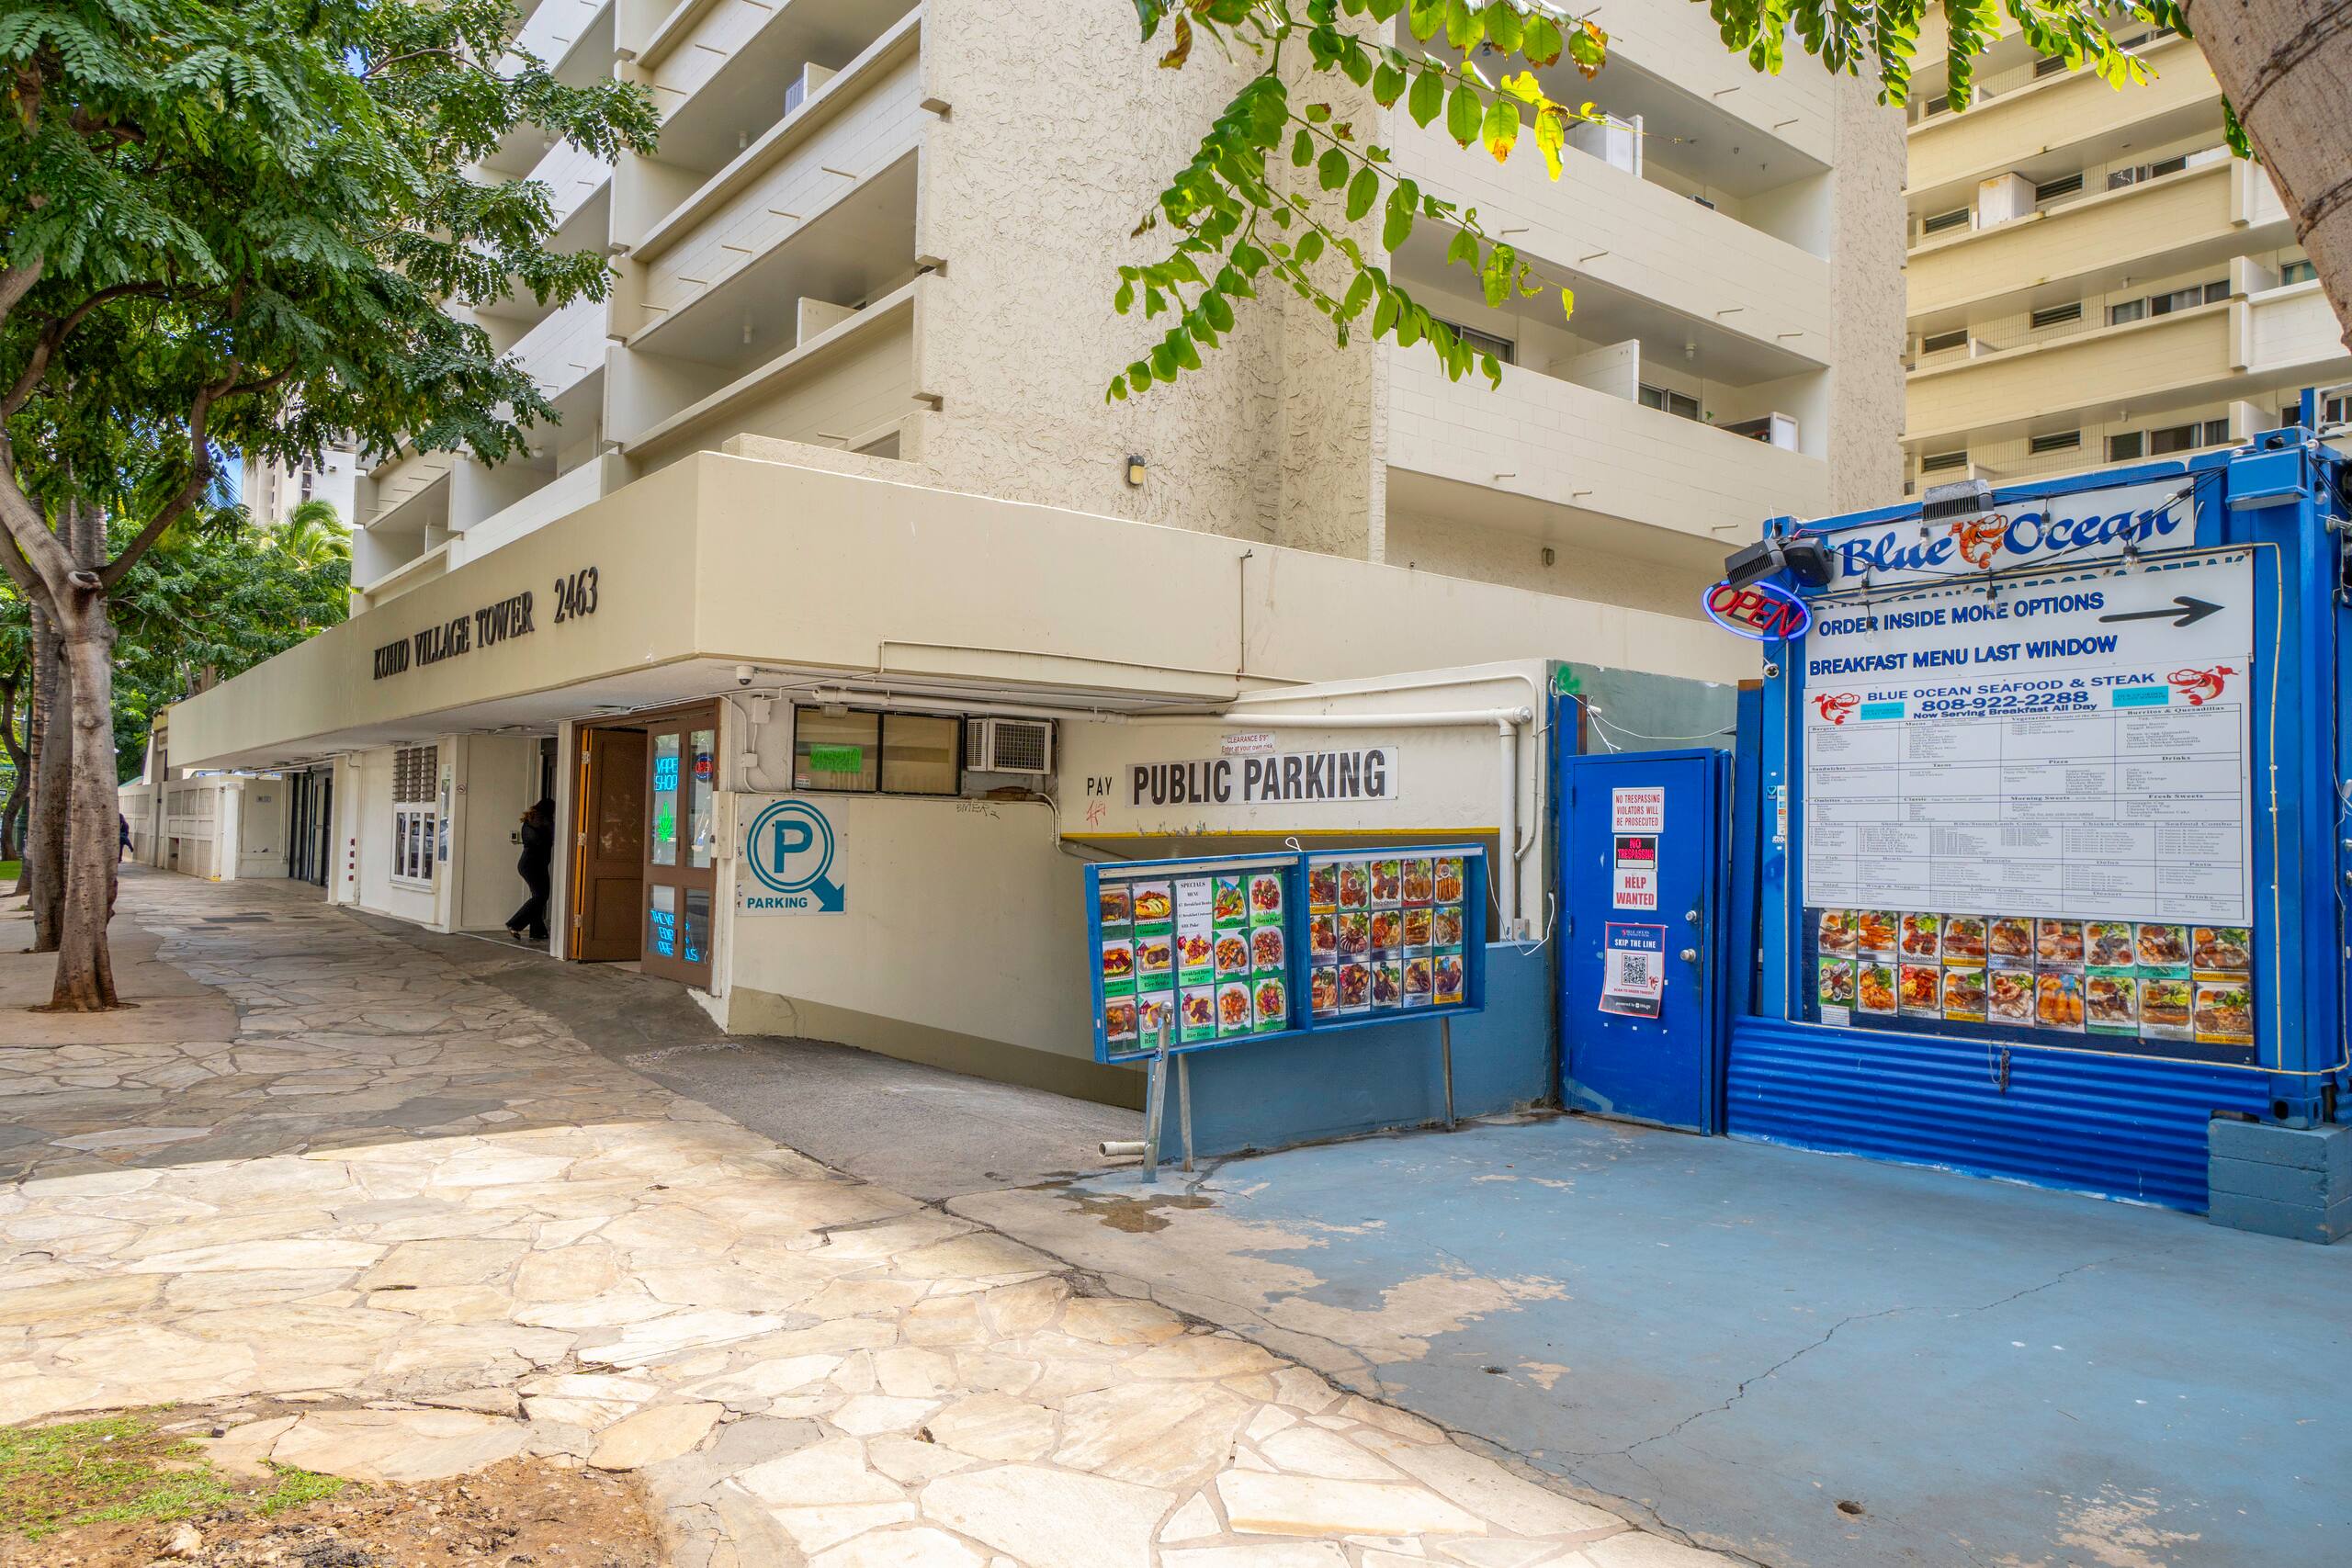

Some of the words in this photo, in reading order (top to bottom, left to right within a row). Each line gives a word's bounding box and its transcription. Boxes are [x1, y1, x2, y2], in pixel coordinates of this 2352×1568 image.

[1839, 531, 1958, 579] Blue
[2003, 505, 2184, 555] Ocean
[553, 566, 598, 624] 2463
[1709, 585, 1804, 637] OPEN
[1818, 616, 1878, 637] ORDER
[1883, 609, 1946, 631] INSIDE
[1951, 602, 2008, 624] MORE
[2014, 592, 2104, 617] OPTIONS
[373, 637, 410, 681] KUHIO
[413, 615, 470, 668] VILLAGE
[475, 591, 535, 649] TOWER
[1809, 653, 1908, 676] BREAKFAST
[1913, 648, 1969, 668] MENU
[1974, 643, 2020, 663] LAST
[2026, 635, 2118, 660] WINDOW
[1867, 690, 1908, 702] BLUE
[1913, 686, 1972, 699] OCEAN
[1977, 680, 2064, 695] SEAFOOD
[2069, 678, 2085, 688] &
[2090, 672, 2156, 687] STEAK
[1921, 690, 2089, 712] 808-922-2288
[1913, 711, 1938, 719] Now
[1940, 708, 1985, 719] Serving
[1988, 704, 2049, 716] Breakfast
[2052, 703, 2069, 712] All
[2072, 702, 2098, 713] Day
[1227, 735, 1258, 745] CLEARANCE
[1221, 745, 1234, 753] Enter
[655, 757, 679, 773] VAPE
[654, 774, 678, 792] SHOP
[1133, 760, 1232, 806] PUBLIC
[1244, 749, 1385, 801] PARKING
[1087, 776, 1113, 796] PAY
[1615, 795, 1623, 804] NO
[1624, 794, 1661, 804] TRESPASSING
[1616, 806, 1645, 816] VIOLATORS
[1646, 806, 1659, 815] WILL
[1616, 817, 1623, 826] BE
[1624, 817, 1659, 827] PROSECUTED
[1629, 837, 1642, 849] NO
[1617, 848, 1655, 860] TRESPASSING
[1624, 875, 1646, 889] HELP
[746, 897, 808, 908] PARKING
[1615, 892, 1655, 906] WANTED
[1614, 938, 1628, 946] SKIP
[1630, 939, 1642, 947] THE
[1643, 940, 1657, 948] LINE
